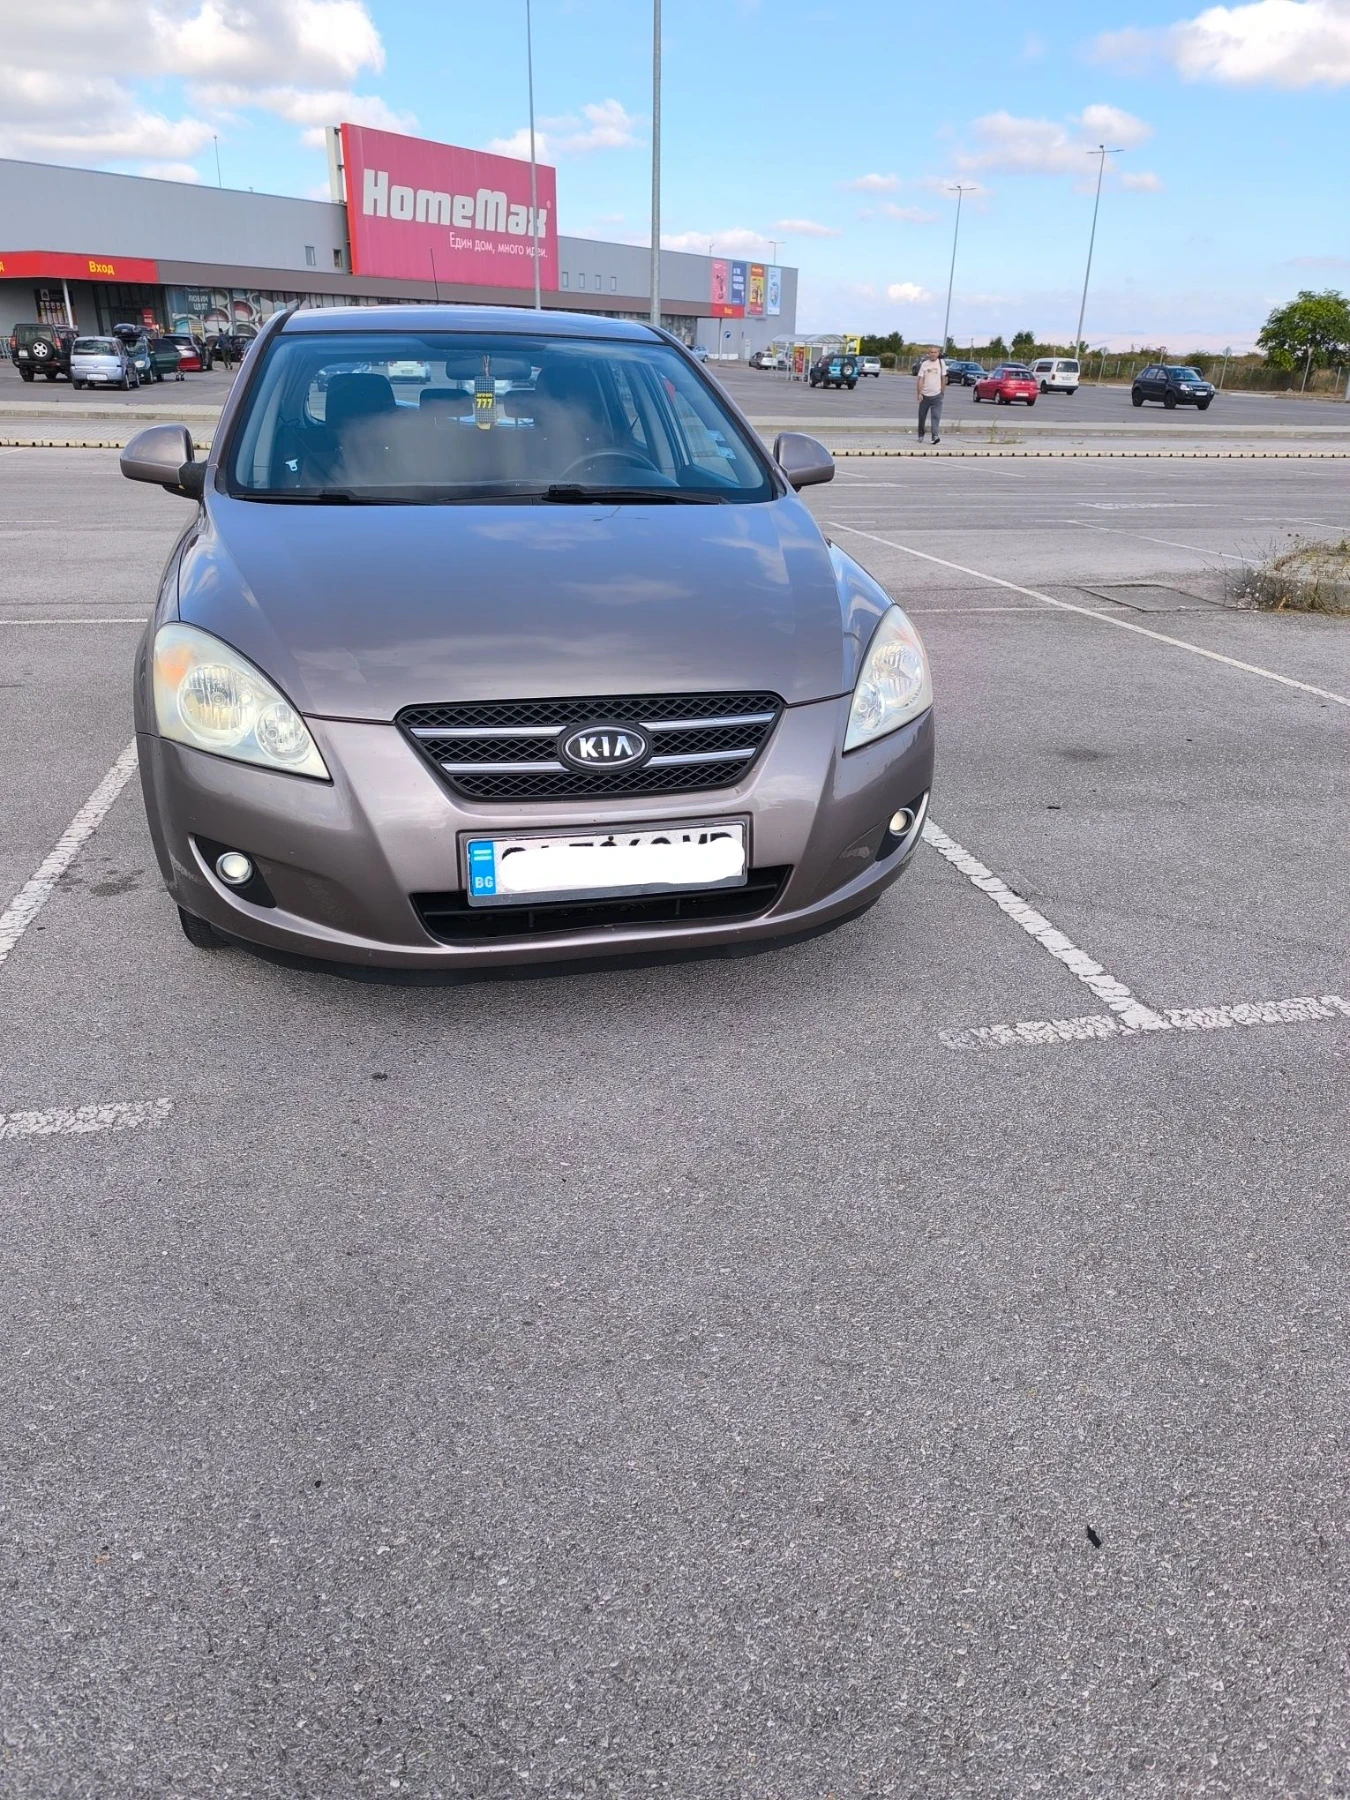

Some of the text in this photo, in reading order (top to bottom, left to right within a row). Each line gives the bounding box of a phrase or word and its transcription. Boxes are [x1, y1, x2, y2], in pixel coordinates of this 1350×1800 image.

[362, 168, 548, 238] HomeMax
[449, 232, 472, 250] Един
[474, 241, 495, 254] дом,
[497, 243, 524, 255] много
[88, 260, 115, 275] Вход
[476, 398, 492, 408] 777
[578, 735, 634, 758] KIA
[475, 876, 494, 888] BG
